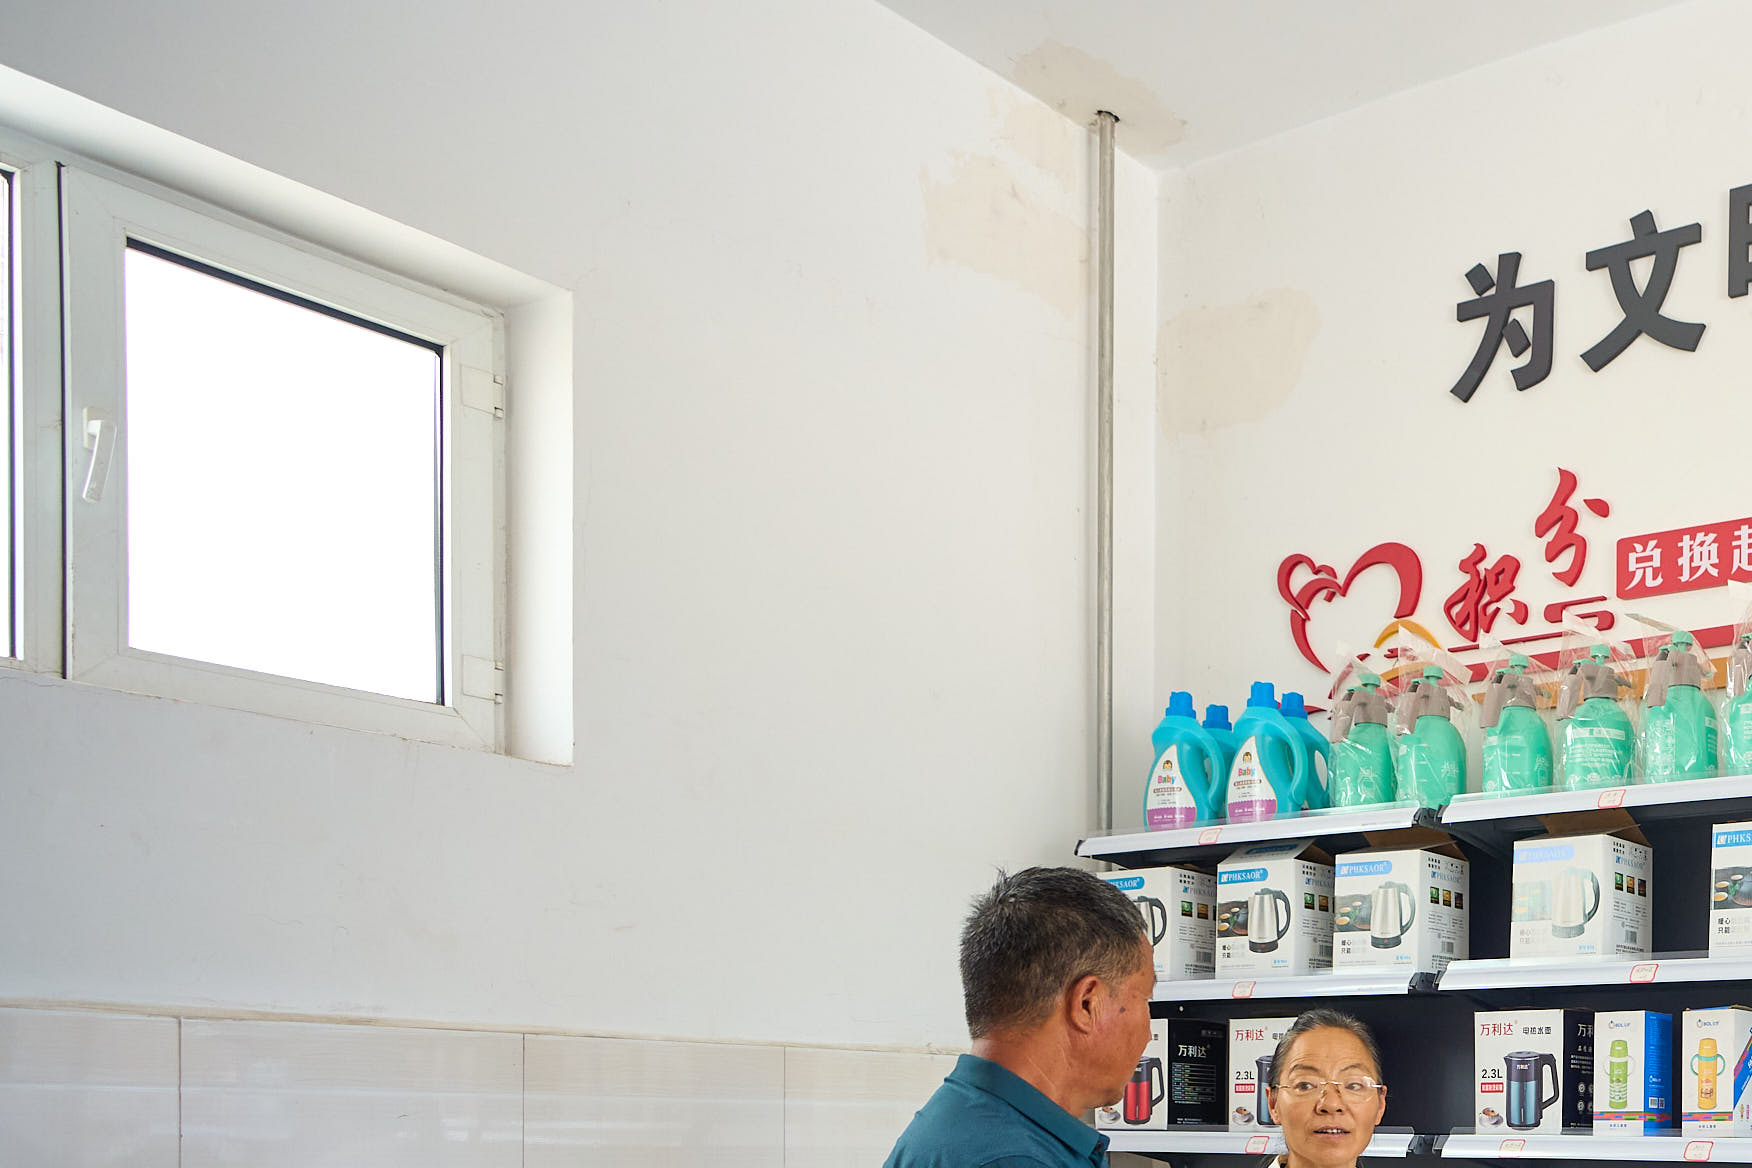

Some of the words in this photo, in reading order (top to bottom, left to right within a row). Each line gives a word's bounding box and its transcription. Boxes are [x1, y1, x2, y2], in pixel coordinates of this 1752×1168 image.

[1238, 767, 1257, 777] Baby
[1157, 775, 1177, 785] Baby
[1349, 860, 1384, 873] PHKSAOR
[1229, 869, 1260, 881] PHKSAOR
[1235, 1029, 1265, 1041] 万利达
[1480, 1023, 1513, 1037] 万利达
[1178, 1044, 1207, 1058] 万利达
[1235, 1071, 1255, 1080] 2.3L
[1481, 1069, 1503, 1079] 2.3L
